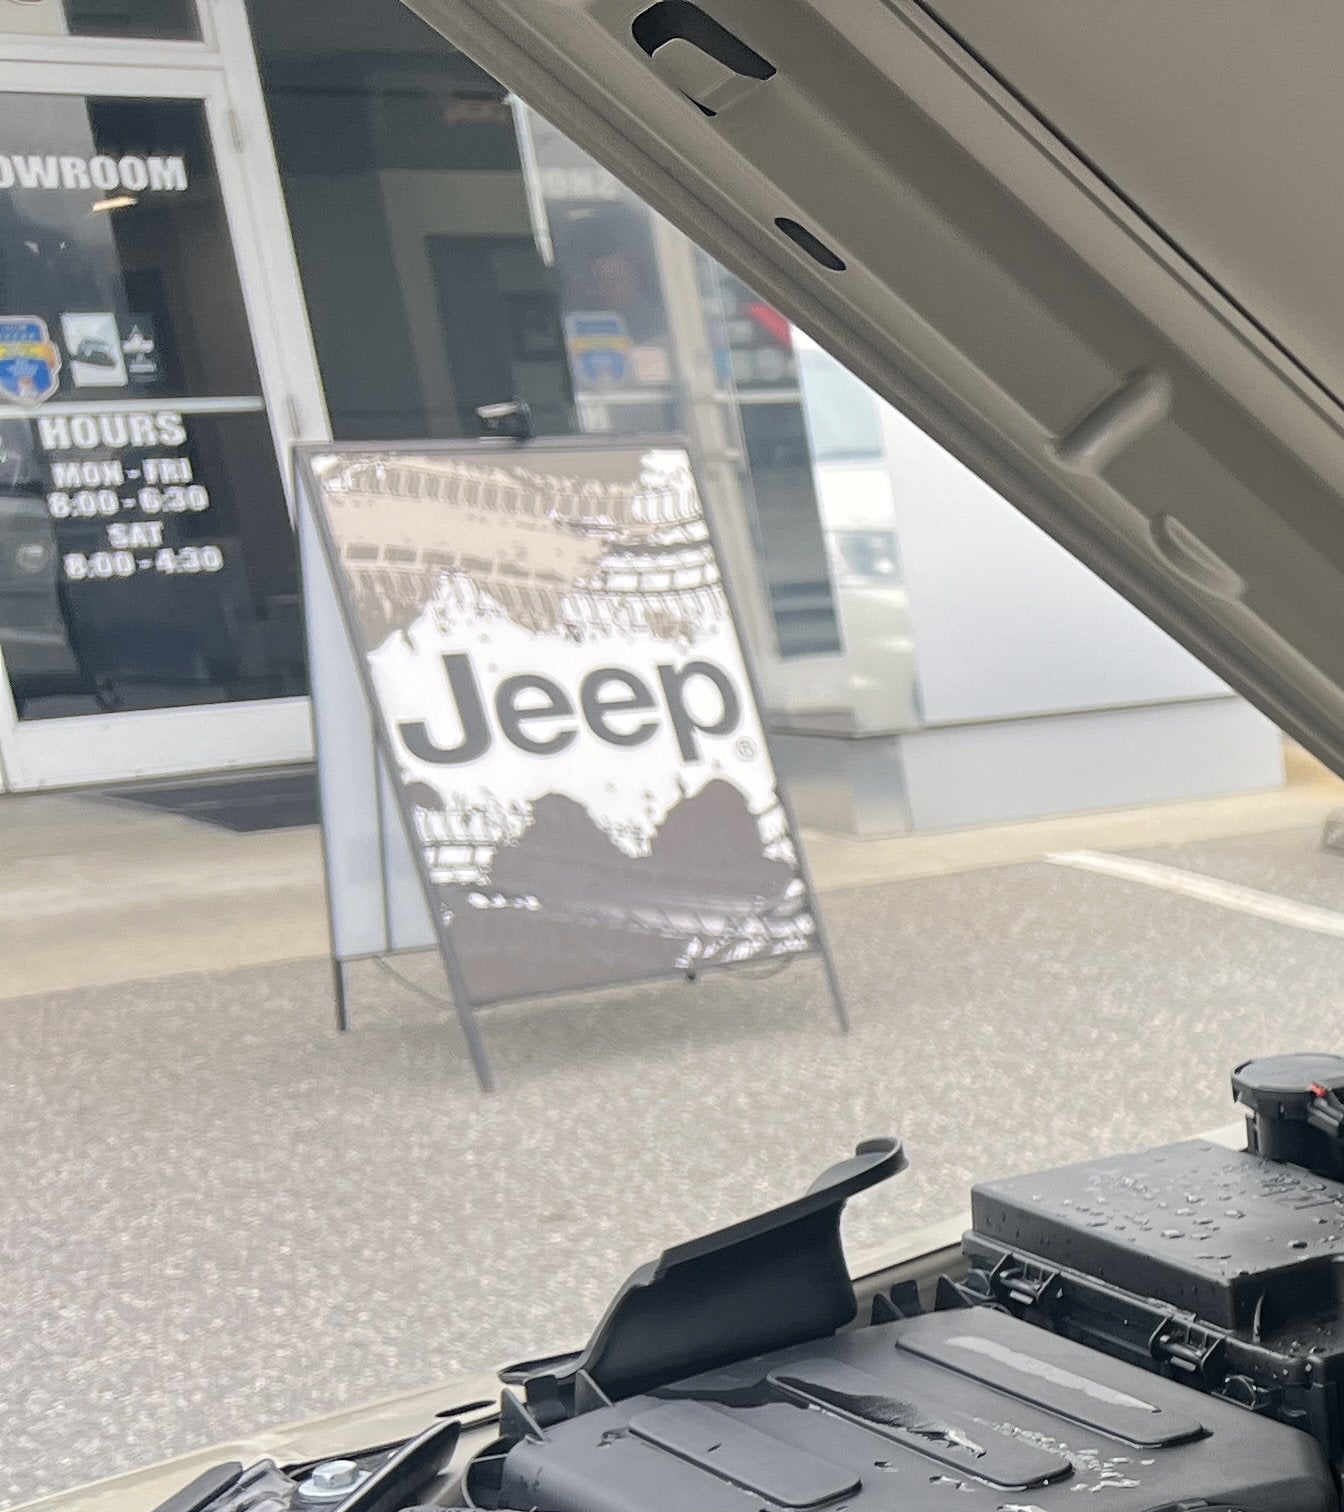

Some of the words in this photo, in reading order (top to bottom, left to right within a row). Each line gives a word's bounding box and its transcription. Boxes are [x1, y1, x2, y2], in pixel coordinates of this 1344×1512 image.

[38, 411, 187, 449] HOURS
[107, 521, 163, 549] SAT
[395, 652, 742, 767] Jeep
